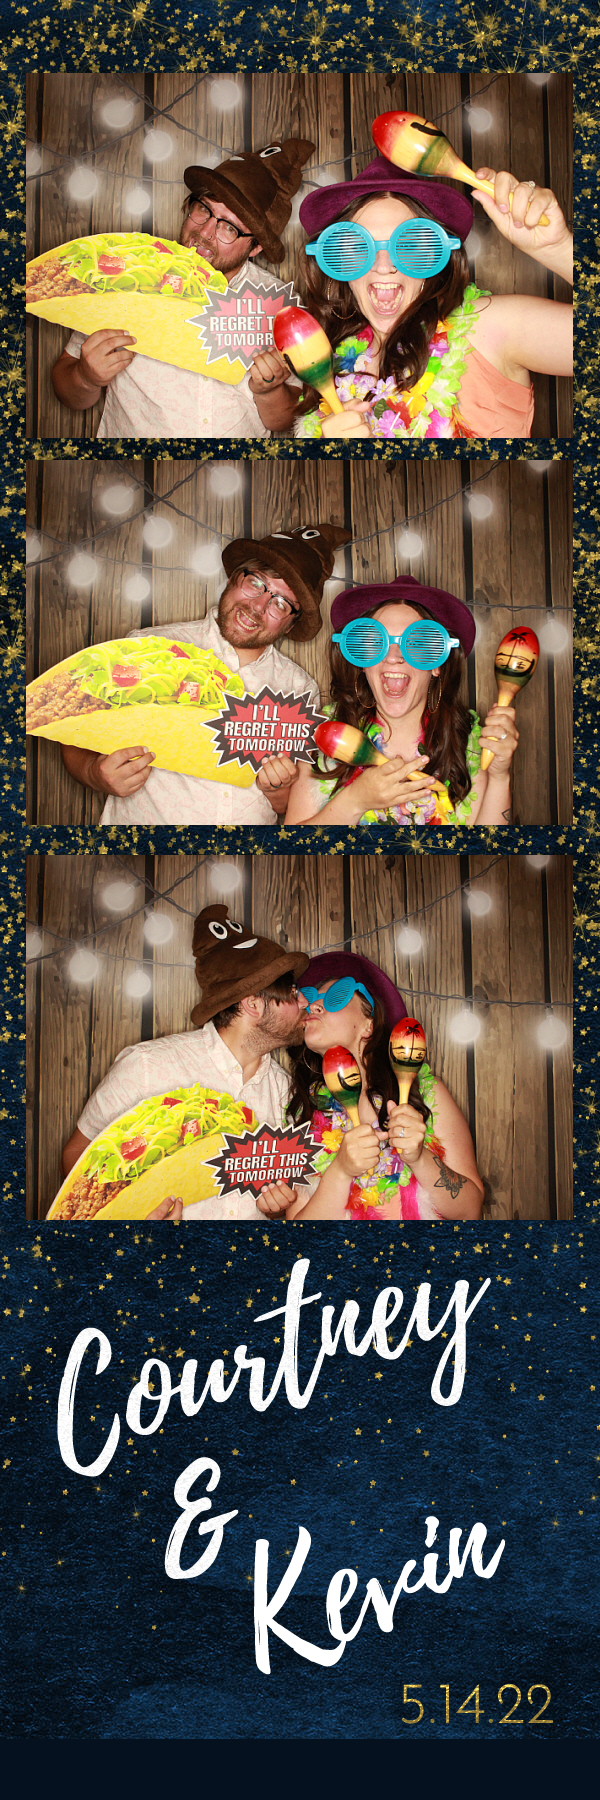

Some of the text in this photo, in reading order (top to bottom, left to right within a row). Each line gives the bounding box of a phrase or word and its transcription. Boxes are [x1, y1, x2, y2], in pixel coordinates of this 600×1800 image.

[236, 298, 266, 315] I'LL
[209, 316, 264, 332] REGRET
[216, 332, 275, 347] TOMORR
[252, 704, 281, 721] I'LL
[223, 721, 311, 738] REGRET THIS
[229, 738, 306, 752] TOMORROW
[251, 1139, 280, 1155] I'LL
[224, 1152, 308, 1172] REGRET THIS
[229, 1166, 304, 1184] TOMORROW
